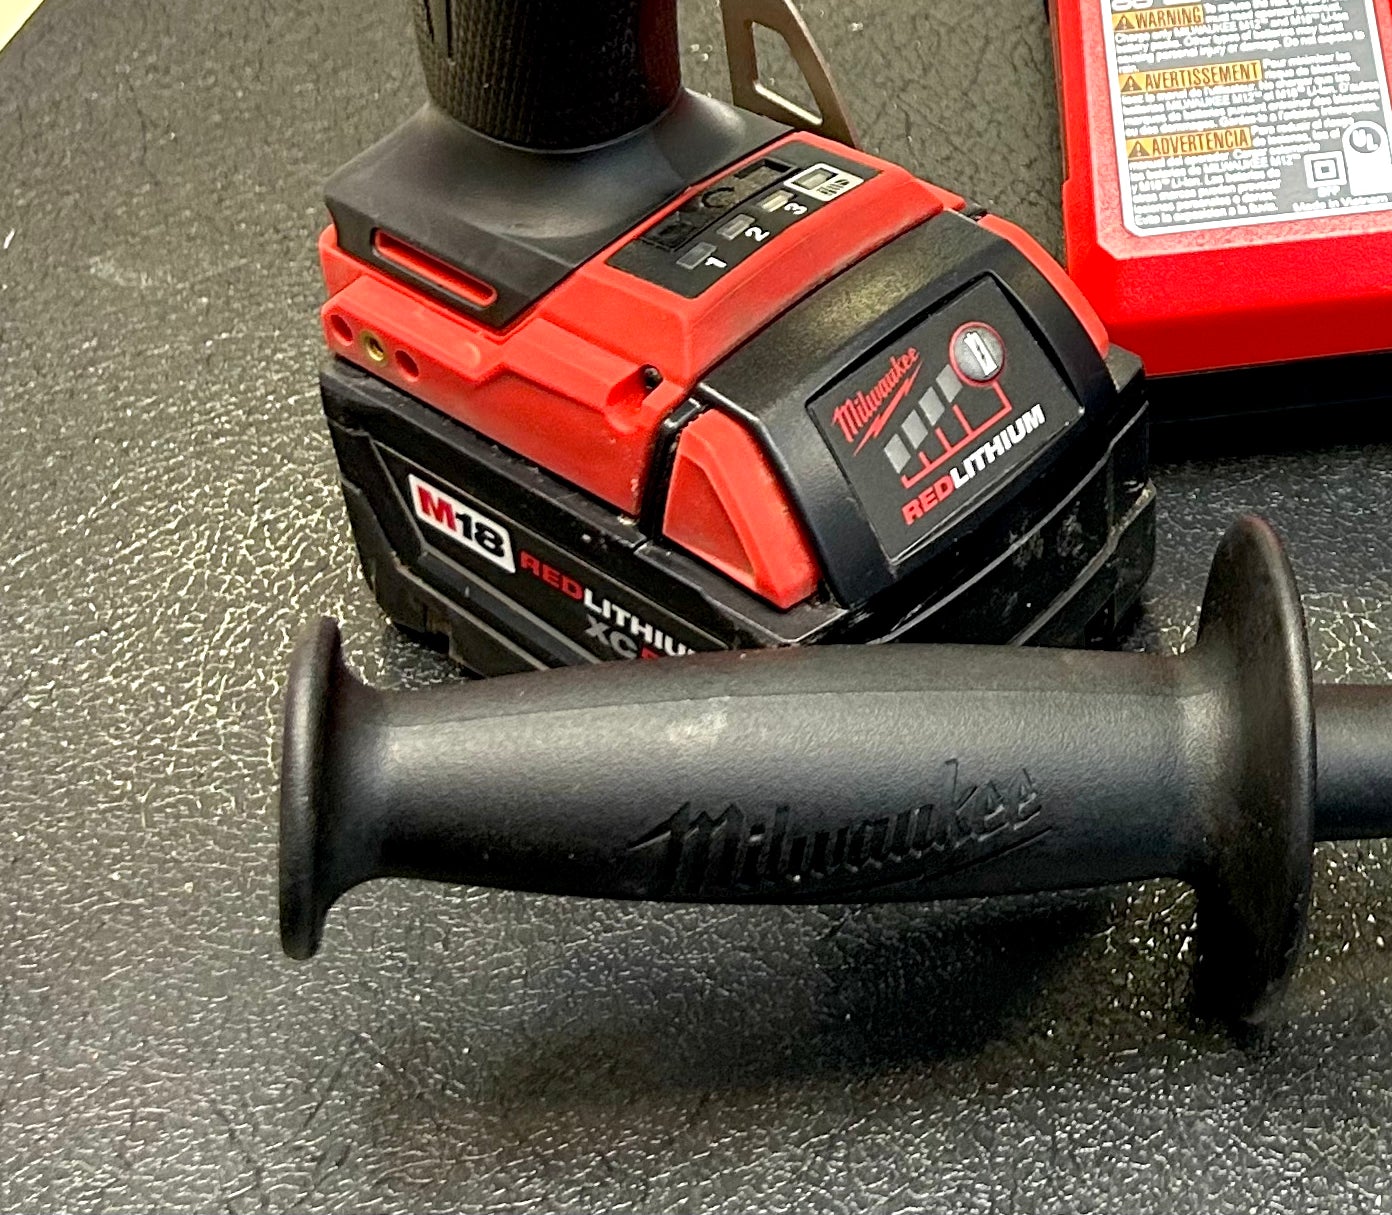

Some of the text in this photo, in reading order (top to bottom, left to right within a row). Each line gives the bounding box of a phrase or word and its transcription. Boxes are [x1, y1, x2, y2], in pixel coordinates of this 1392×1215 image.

[1135, 6, 1202, 29] WARNING
[1144, 61, 1258, 91] AVERTISSEMENT
[1151, 128, 1248, 156] ADVERTENCIA
[704, 201, 808, 269] 1 2 3
[832, 346, 920, 444] Milwaukee
[901, 402, 1046, 526] REDLITHIUM
[417, 485, 696, 656] M18 REDLITHIU
[628, 758, 1044, 896] Milwaukee
